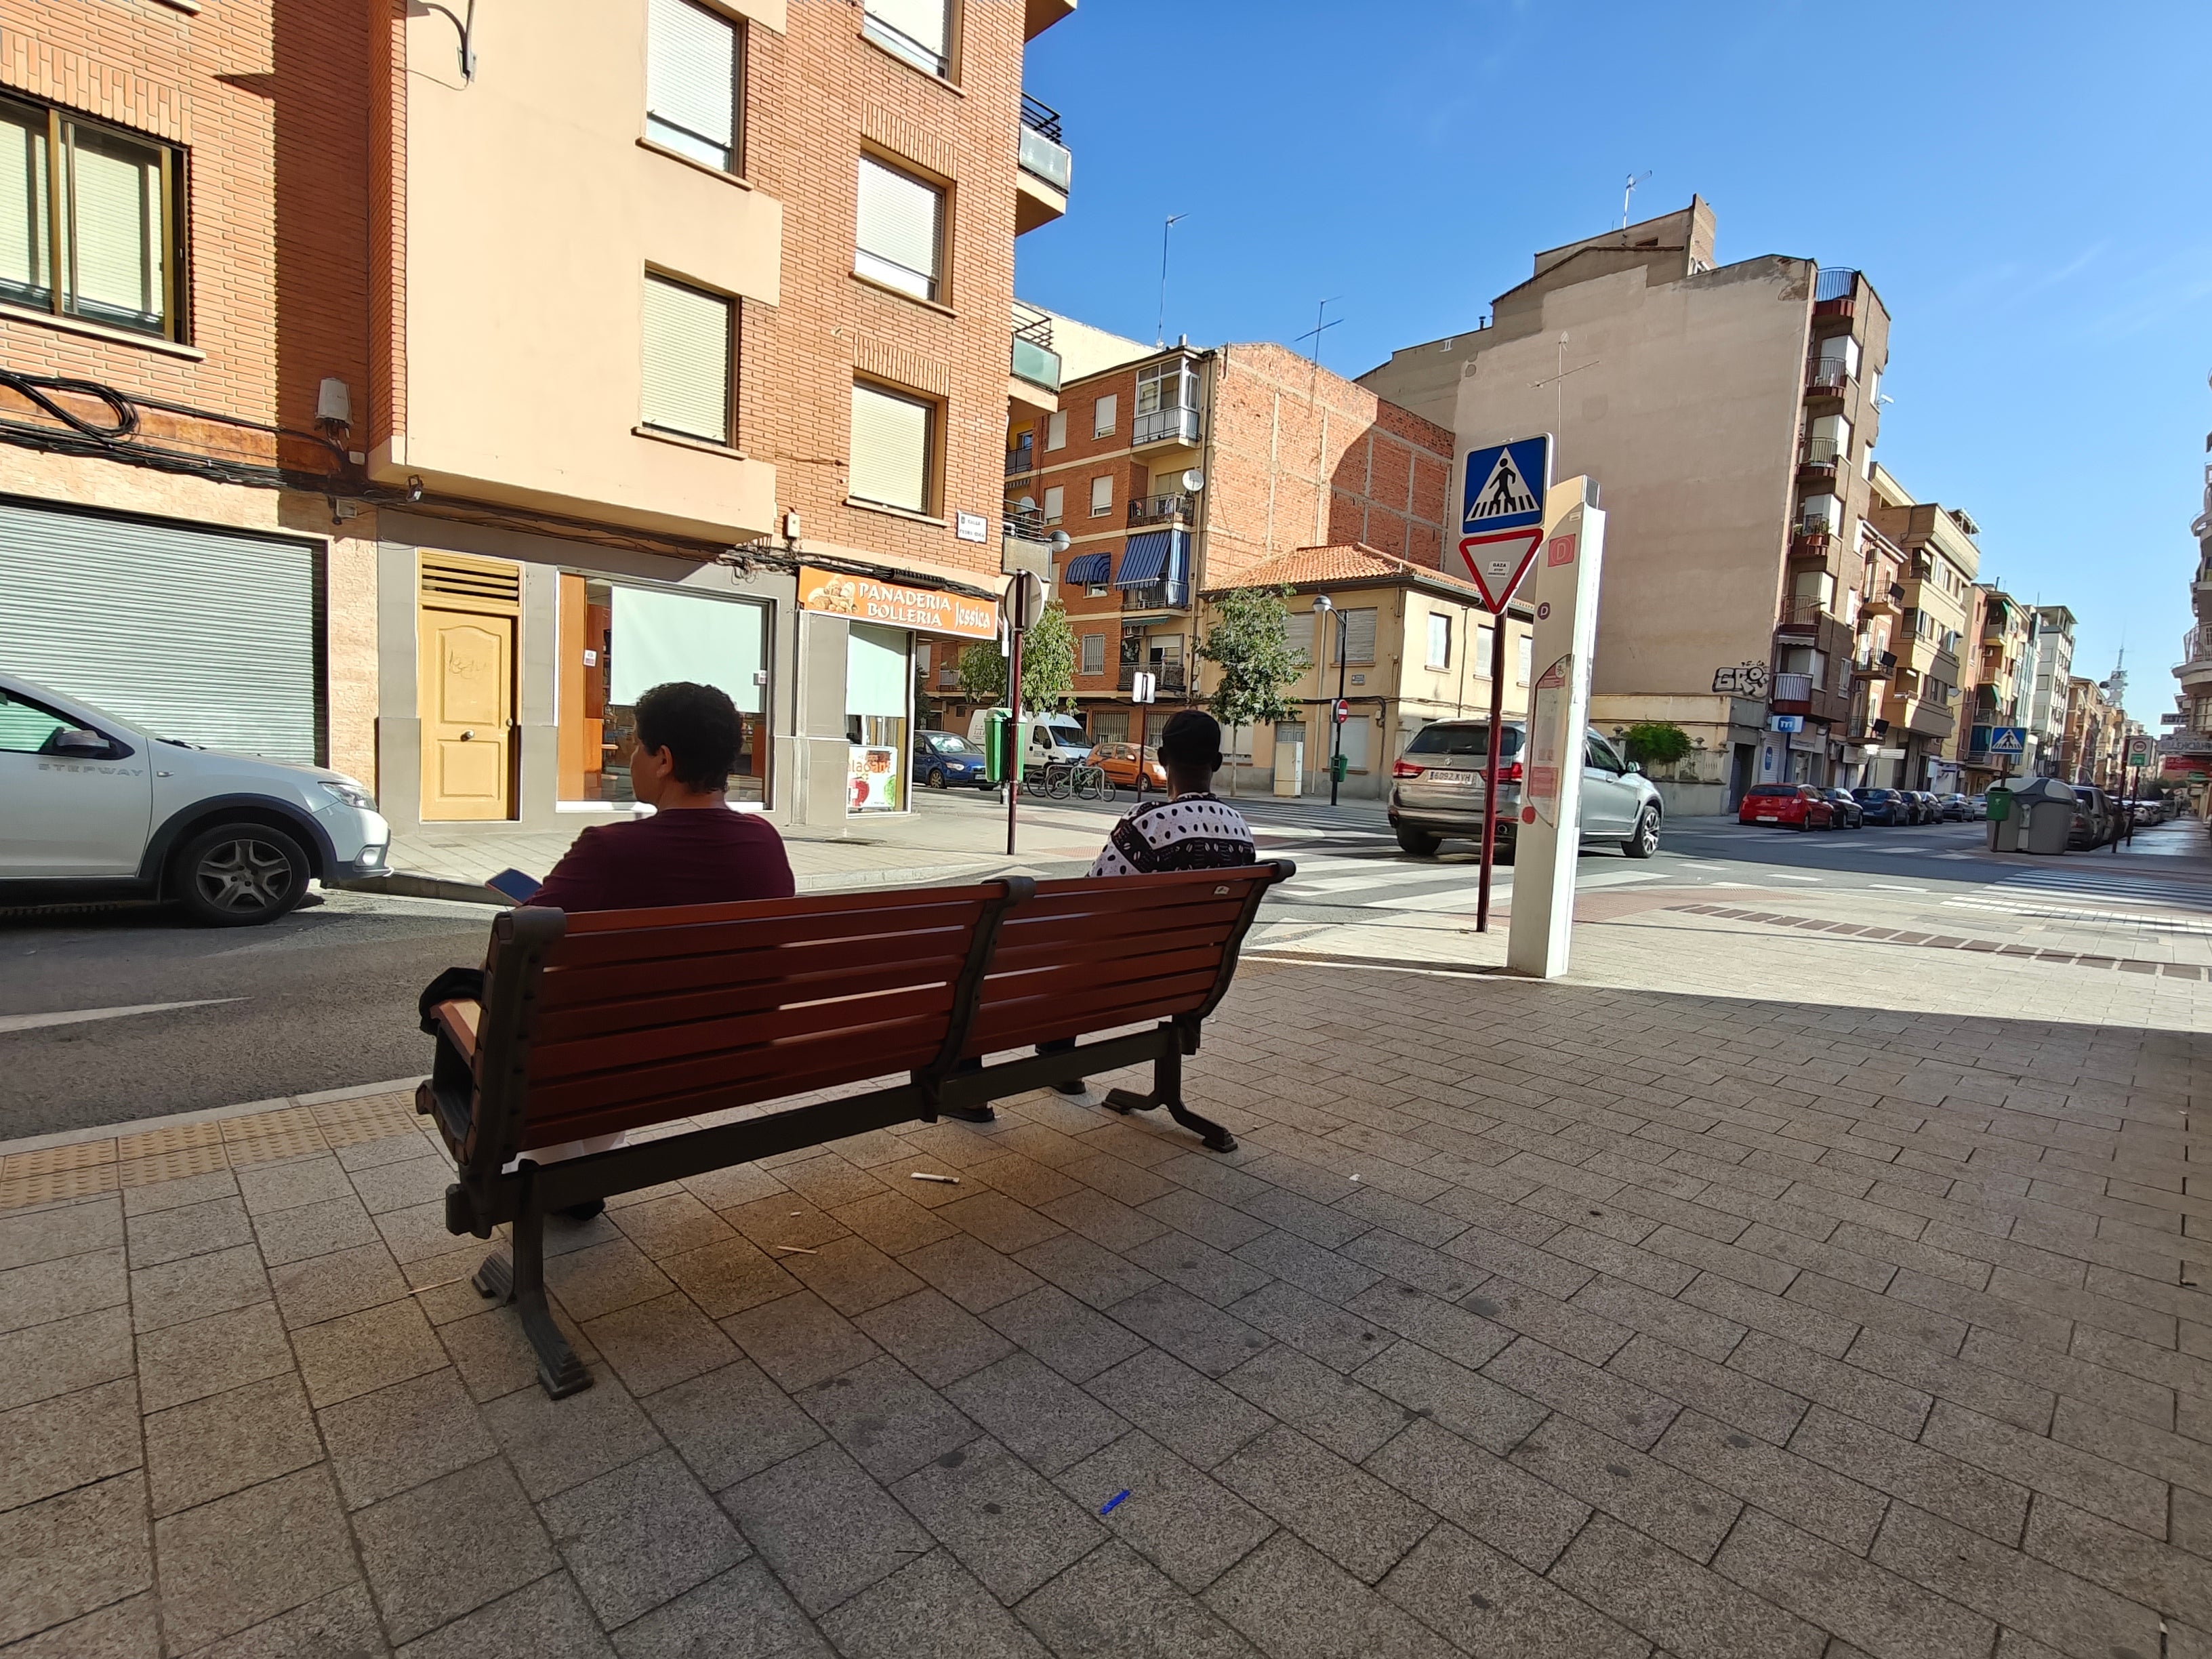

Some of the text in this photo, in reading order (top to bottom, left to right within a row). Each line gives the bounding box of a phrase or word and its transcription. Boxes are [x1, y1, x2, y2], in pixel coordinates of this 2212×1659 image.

[859, 582, 951, 611] PANADERIA
[867, 602, 943, 628] BOLLERIA
[1540, 606, 1549, 616] D
[38, 763, 143, 777] STEPWAY
